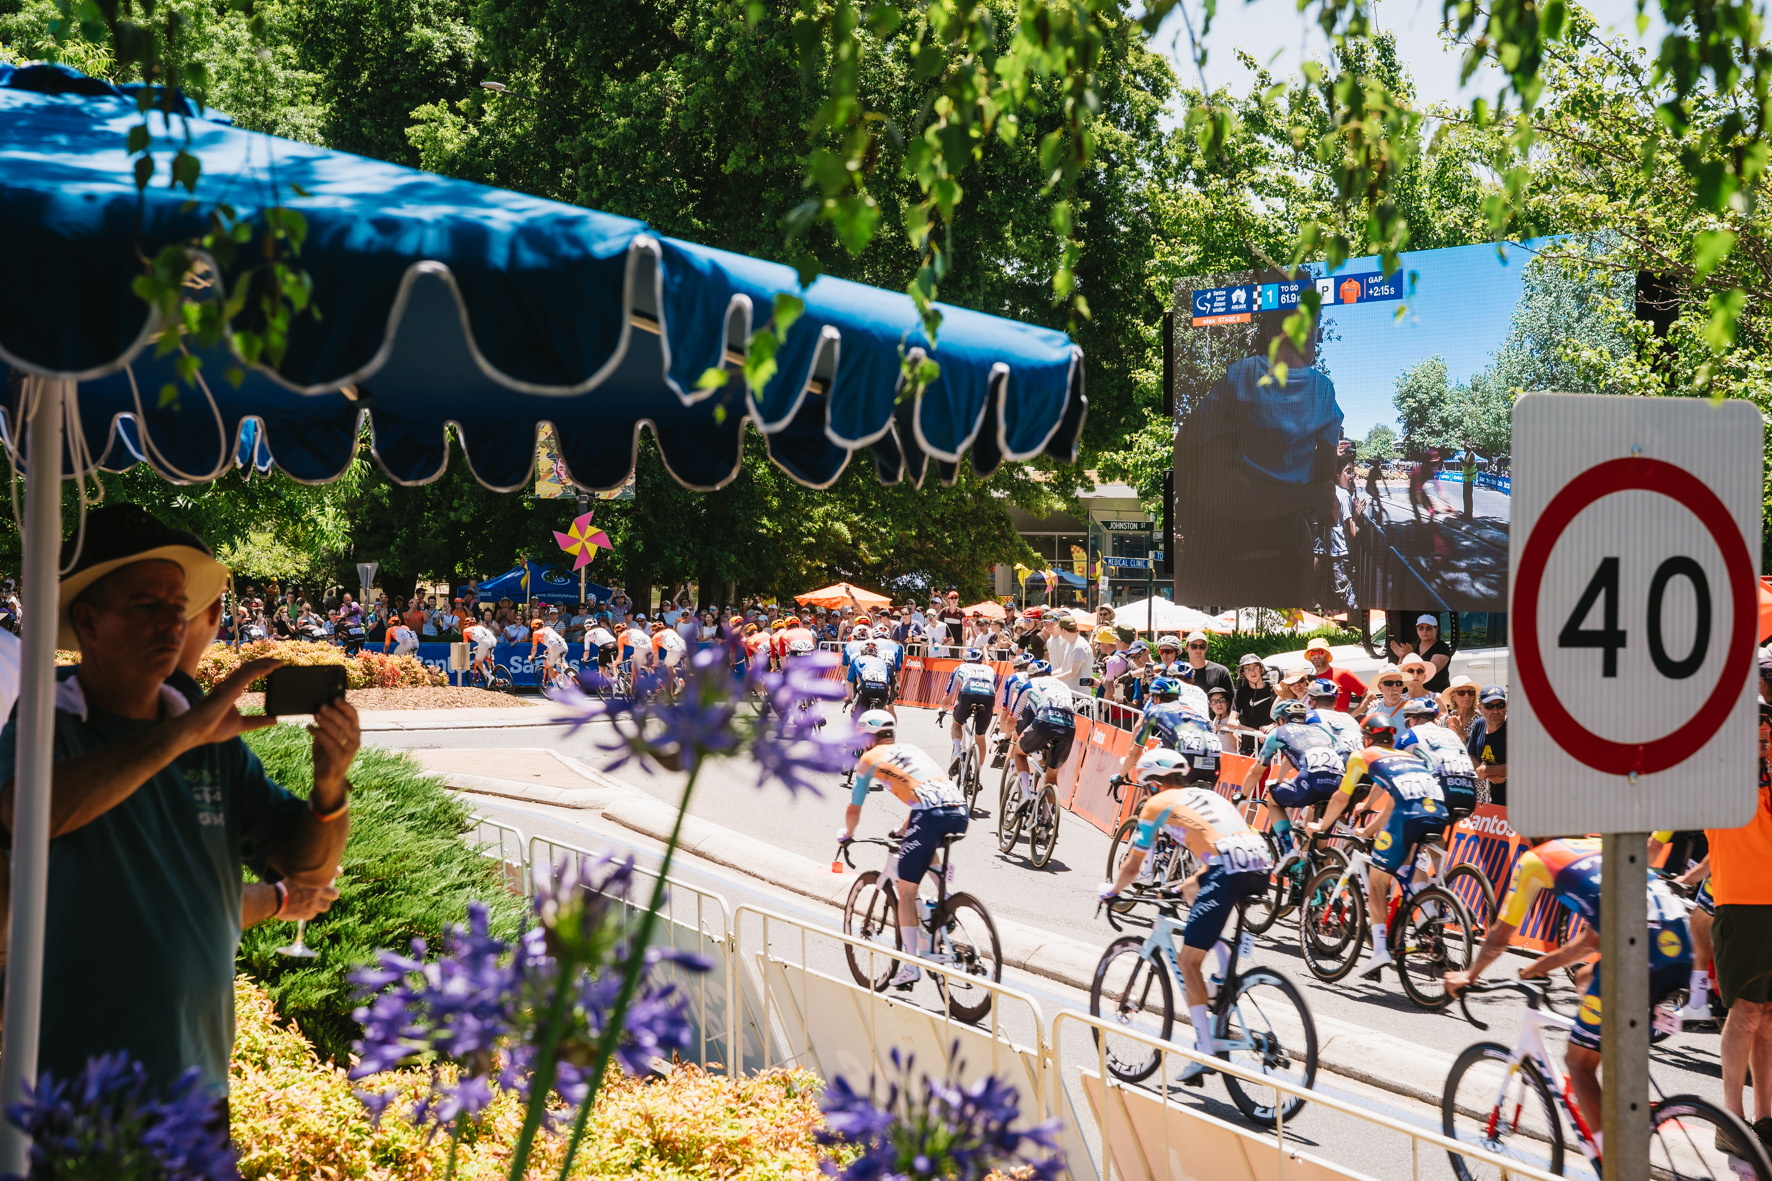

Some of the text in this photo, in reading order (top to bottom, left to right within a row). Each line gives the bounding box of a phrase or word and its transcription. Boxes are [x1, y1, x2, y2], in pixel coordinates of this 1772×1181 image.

[1368, 276, 1383, 284] GAP
[1266, 289, 1273, 303] 1
[1321, 286, 1329, 297] P
[1108, 521, 1138, 530] JOHNSTON
[1107, 558, 1146, 568] MEDICAL CLINIC
[1557, 555, 1712, 679] 40
[1048, 709, 1072, 720] BORA
[1446, 777, 1475, 789] BORA
[1170, 813, 1209, 832] SCOTT
